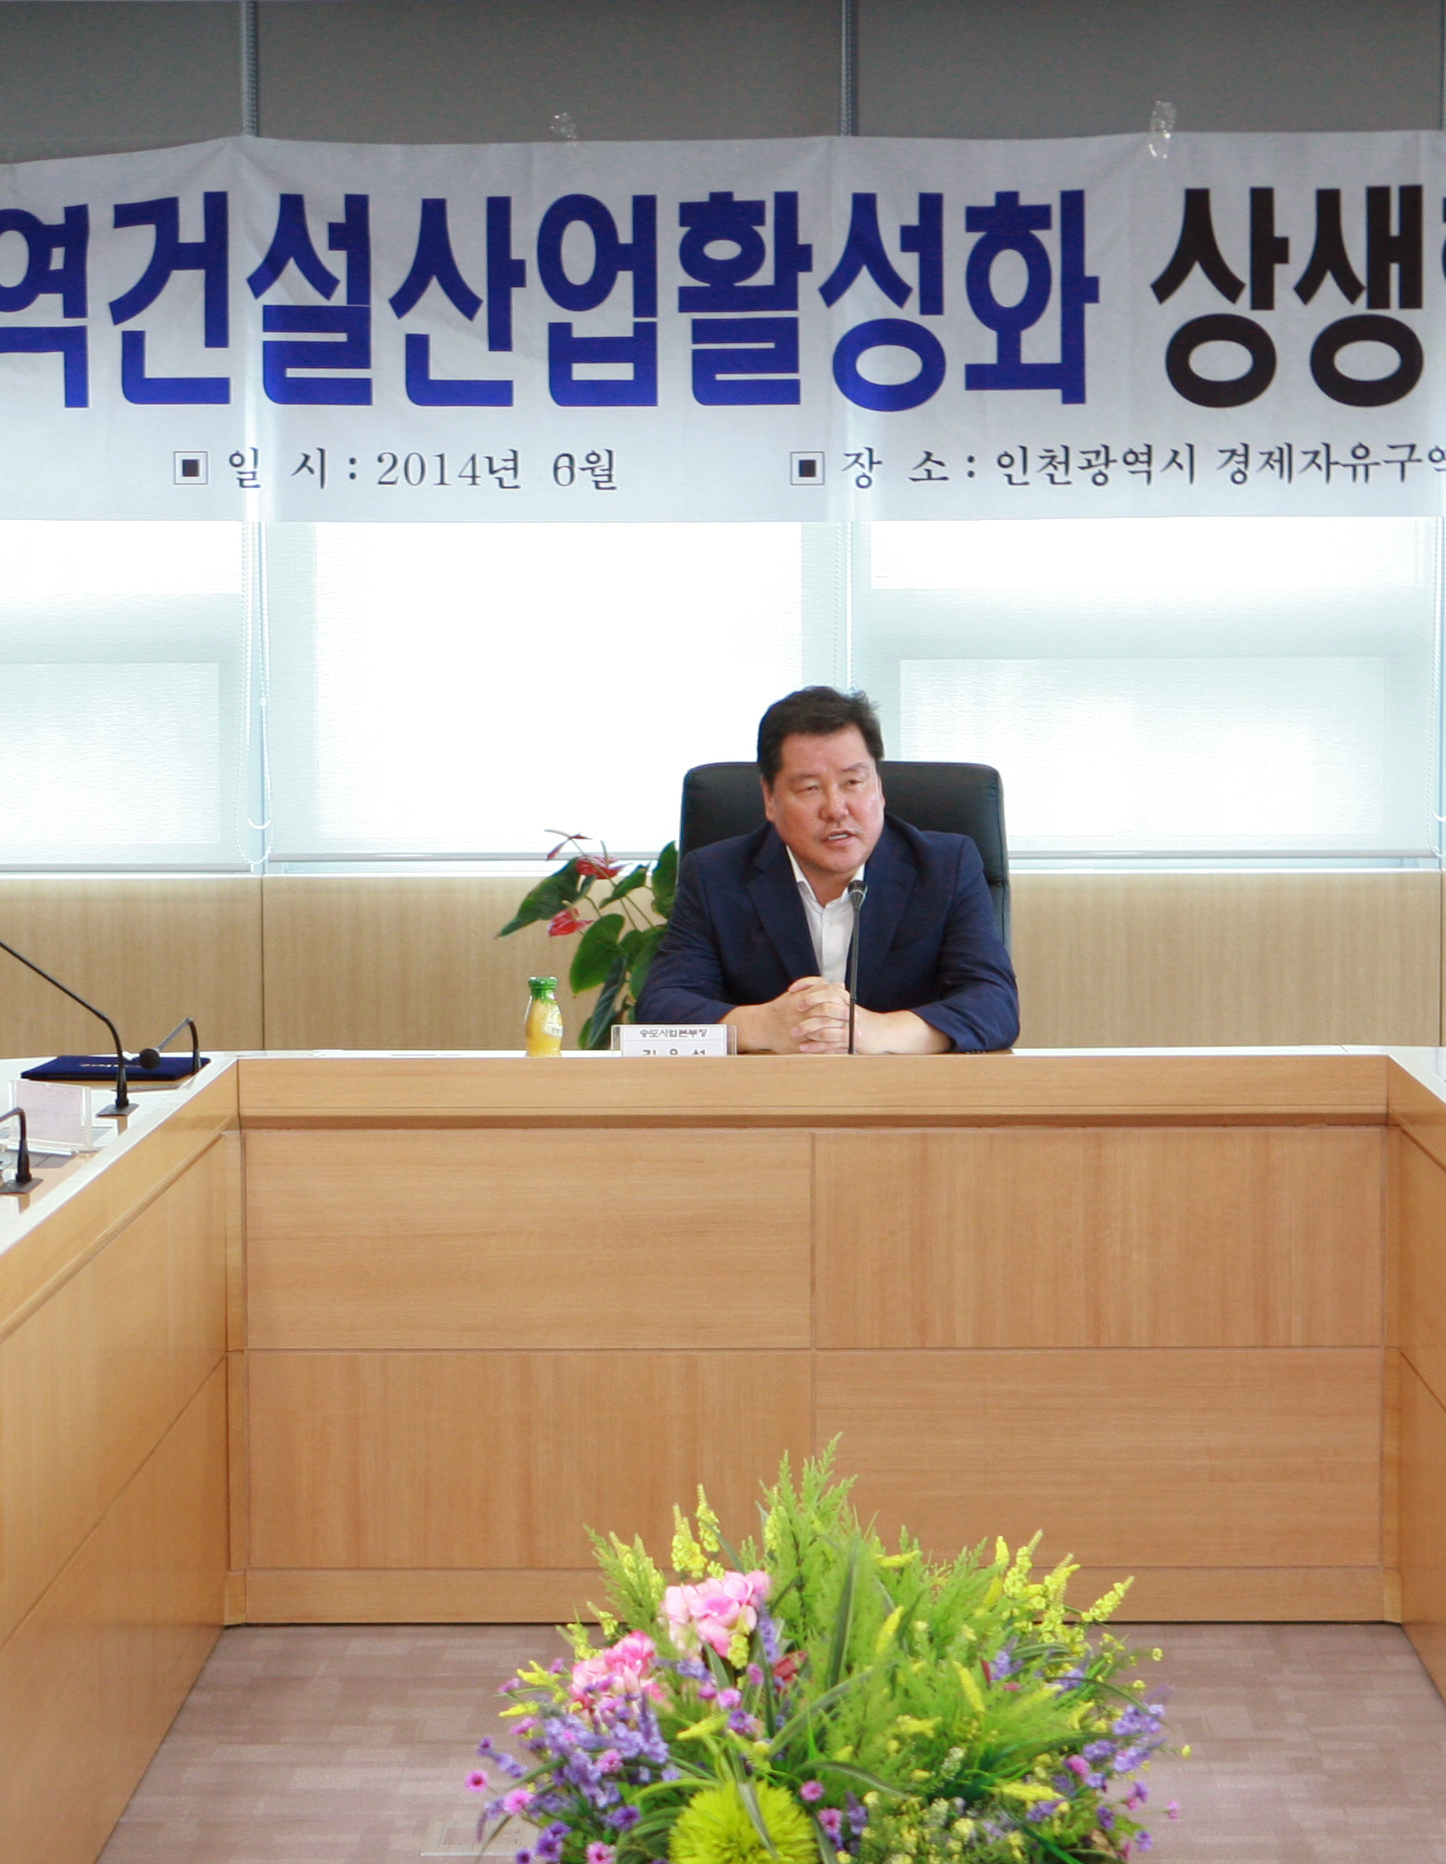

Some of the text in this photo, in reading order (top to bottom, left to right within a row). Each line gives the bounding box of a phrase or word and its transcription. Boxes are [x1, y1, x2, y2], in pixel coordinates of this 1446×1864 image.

[227, 446, 262, 490] 일
[289, 446, 327, 491] 시
[376, 448, 522, 490] 2014년
[552, 448, 618, 491] 6월
[842, 446, 883, 490] 장
[907, 449, 951, 484] 소
[994, 441, 1197, 488] 인천광역시
